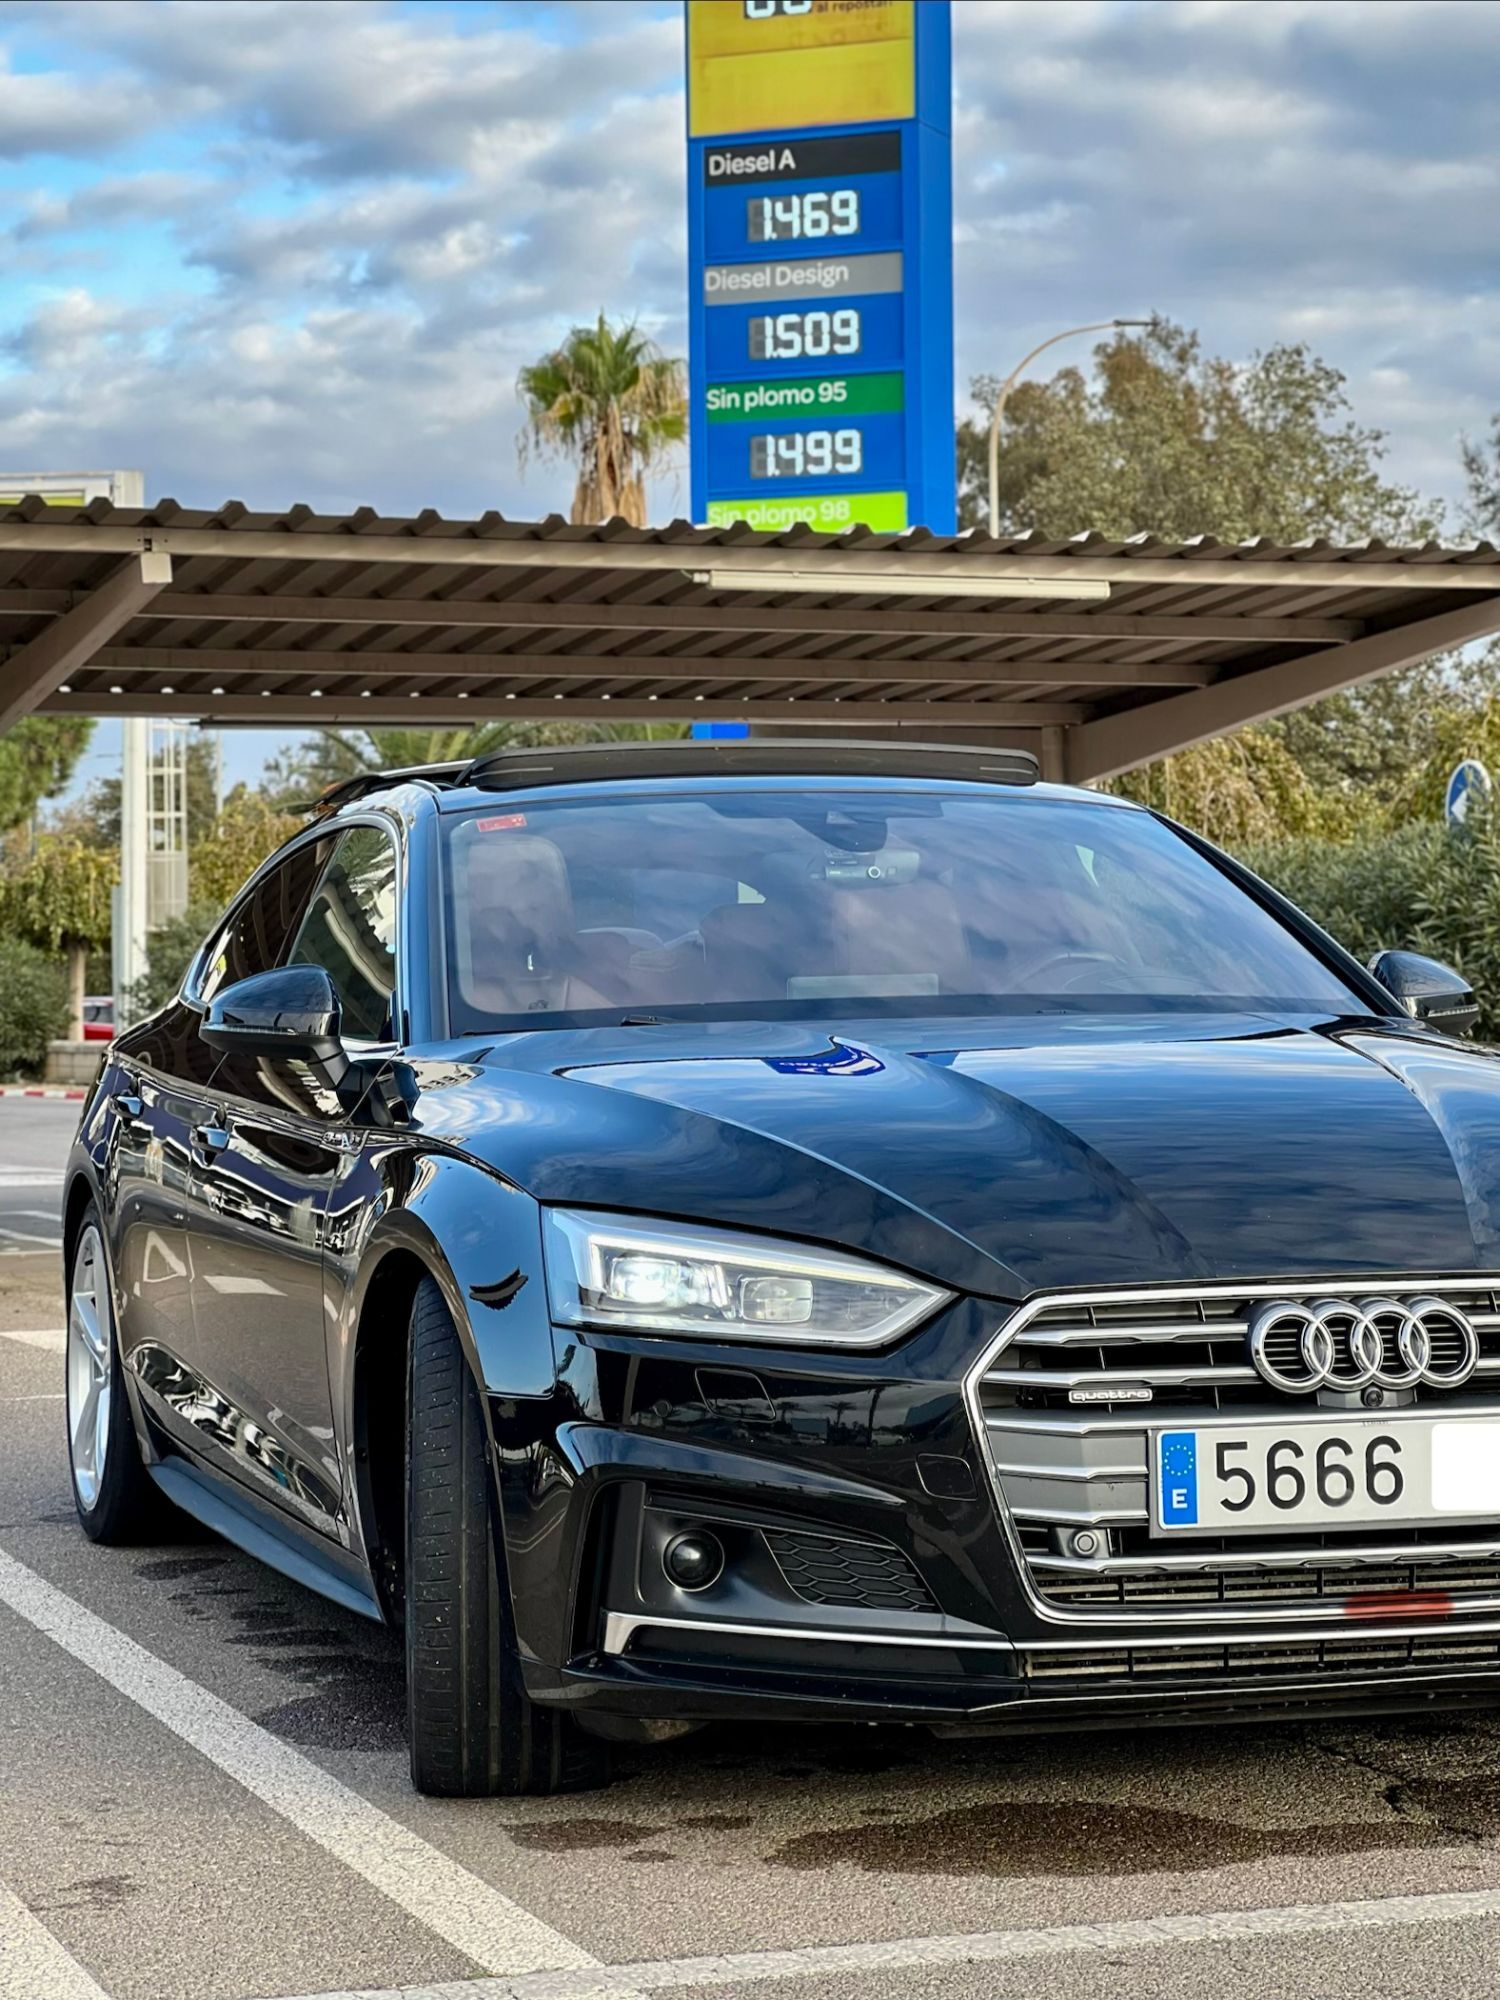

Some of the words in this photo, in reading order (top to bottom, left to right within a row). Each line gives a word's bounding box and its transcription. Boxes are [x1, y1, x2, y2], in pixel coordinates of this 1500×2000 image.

[708, 150, 776, 176] Diesel
[778, 149, 796, 170] A
[763, 190, 858, 240] 1.469
[705, 267, 771, 291] Diesel
[775, 263, 849, 288] Design
[764, 309, 860, 359] 1.509
[706, 389, 741, 410] Sin
[744, 386, 815, 412] plomo
[818, 381, 847, 402] 95
[766, 429, 862, 477] 1.499
[707, 505, 741, 526] Sin
[819, 500, 851, 522] 98
[1073, 1390, 1149, 1402] quattro
[1172, 1488, 1188, 1509] E
[1216, 1436, 1404, 1512] 5666
